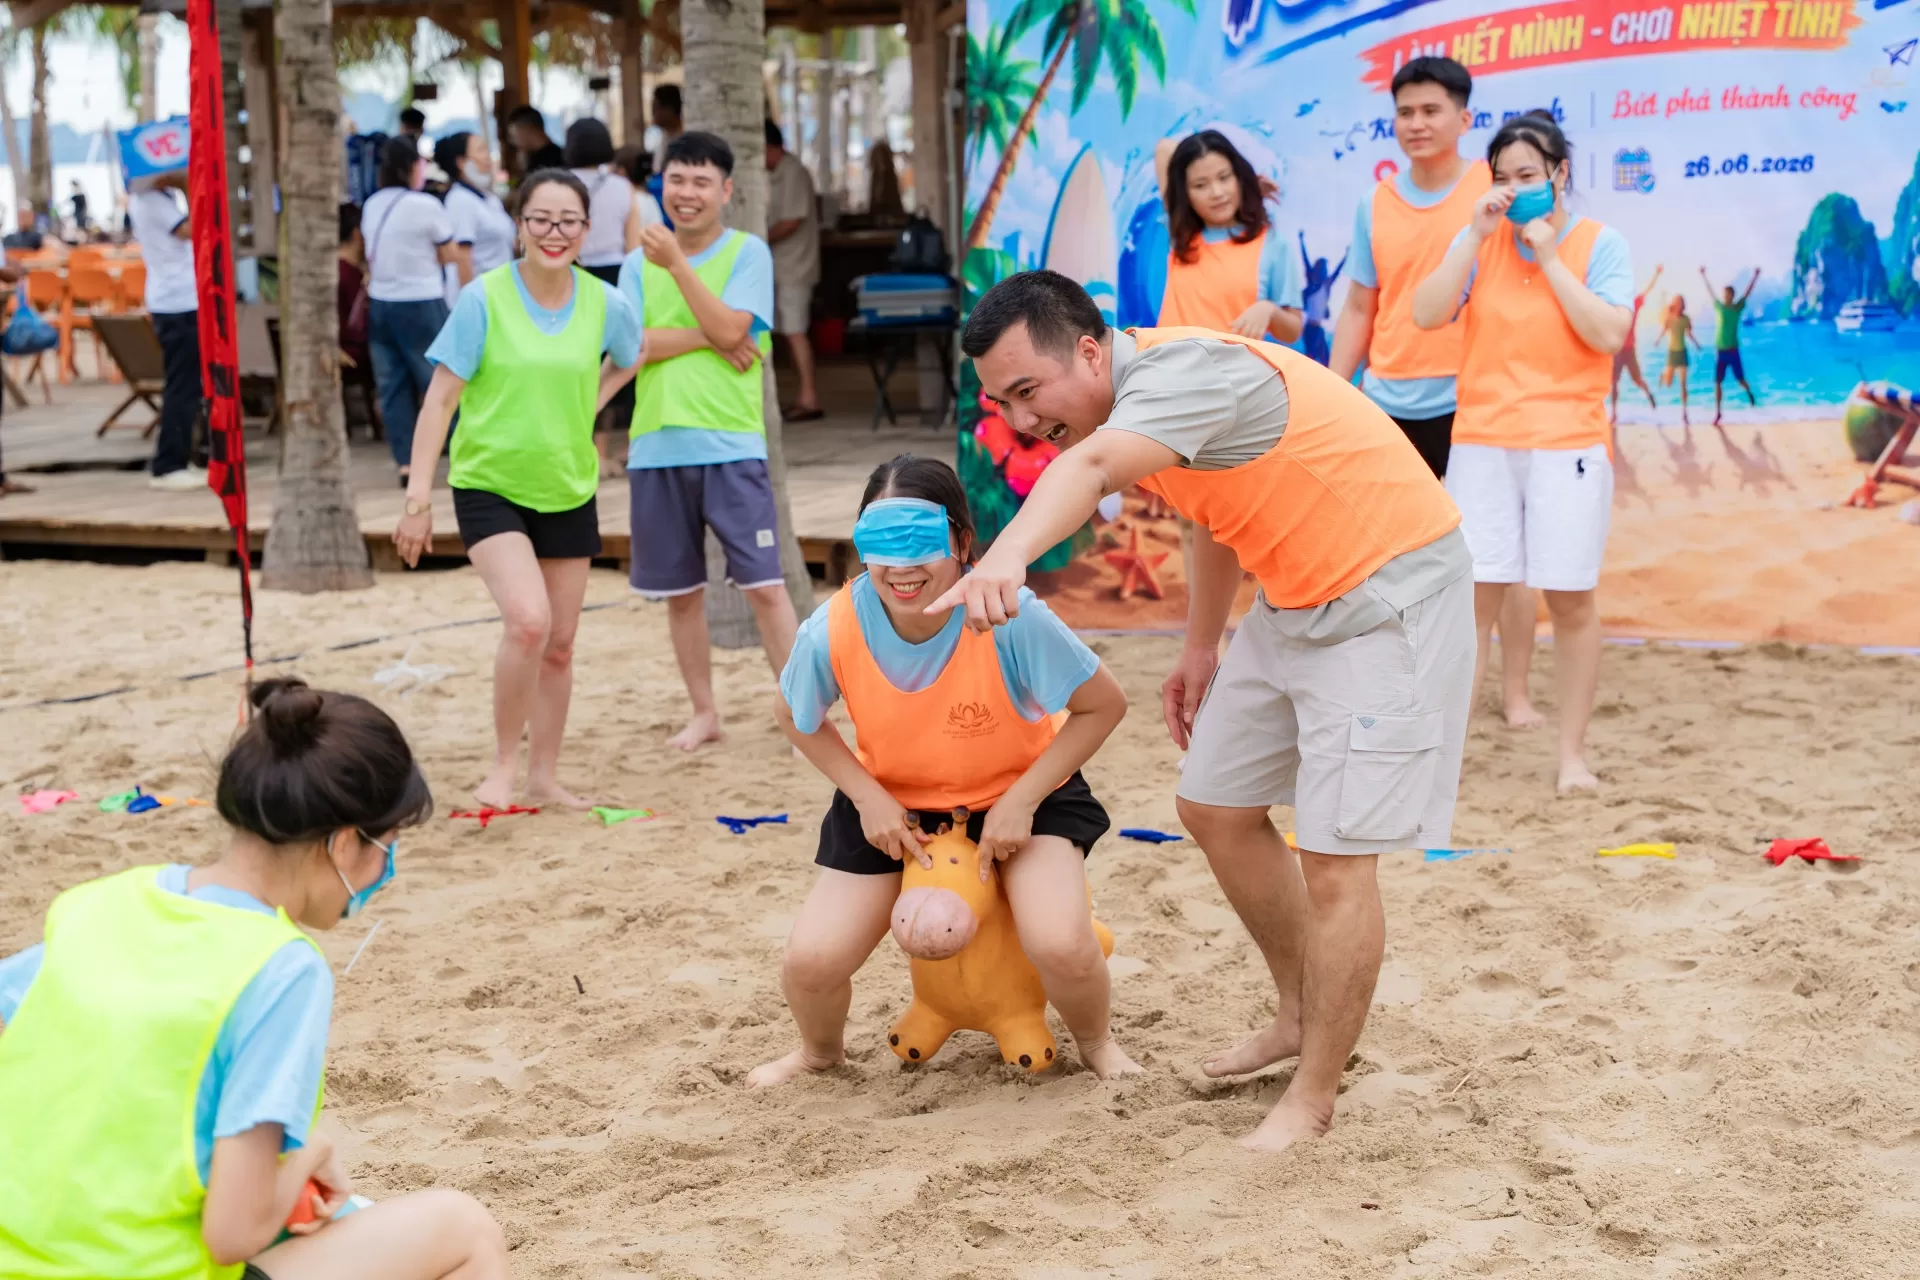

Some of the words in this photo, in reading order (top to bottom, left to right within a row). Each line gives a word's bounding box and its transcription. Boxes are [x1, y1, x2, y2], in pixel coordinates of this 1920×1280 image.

[1451, 17, 1505, 67] HẾT
[1508, 12, 1585, 60] MÌNH
[1678, 0, 1769, 46] NHIỆT
[1774, 0, 1842, 39] TÌNH
[1665, 85, 1711, 119] phá
[1720, 83, 1792, 111] thành
[1799, 84, 1858, 121] công
